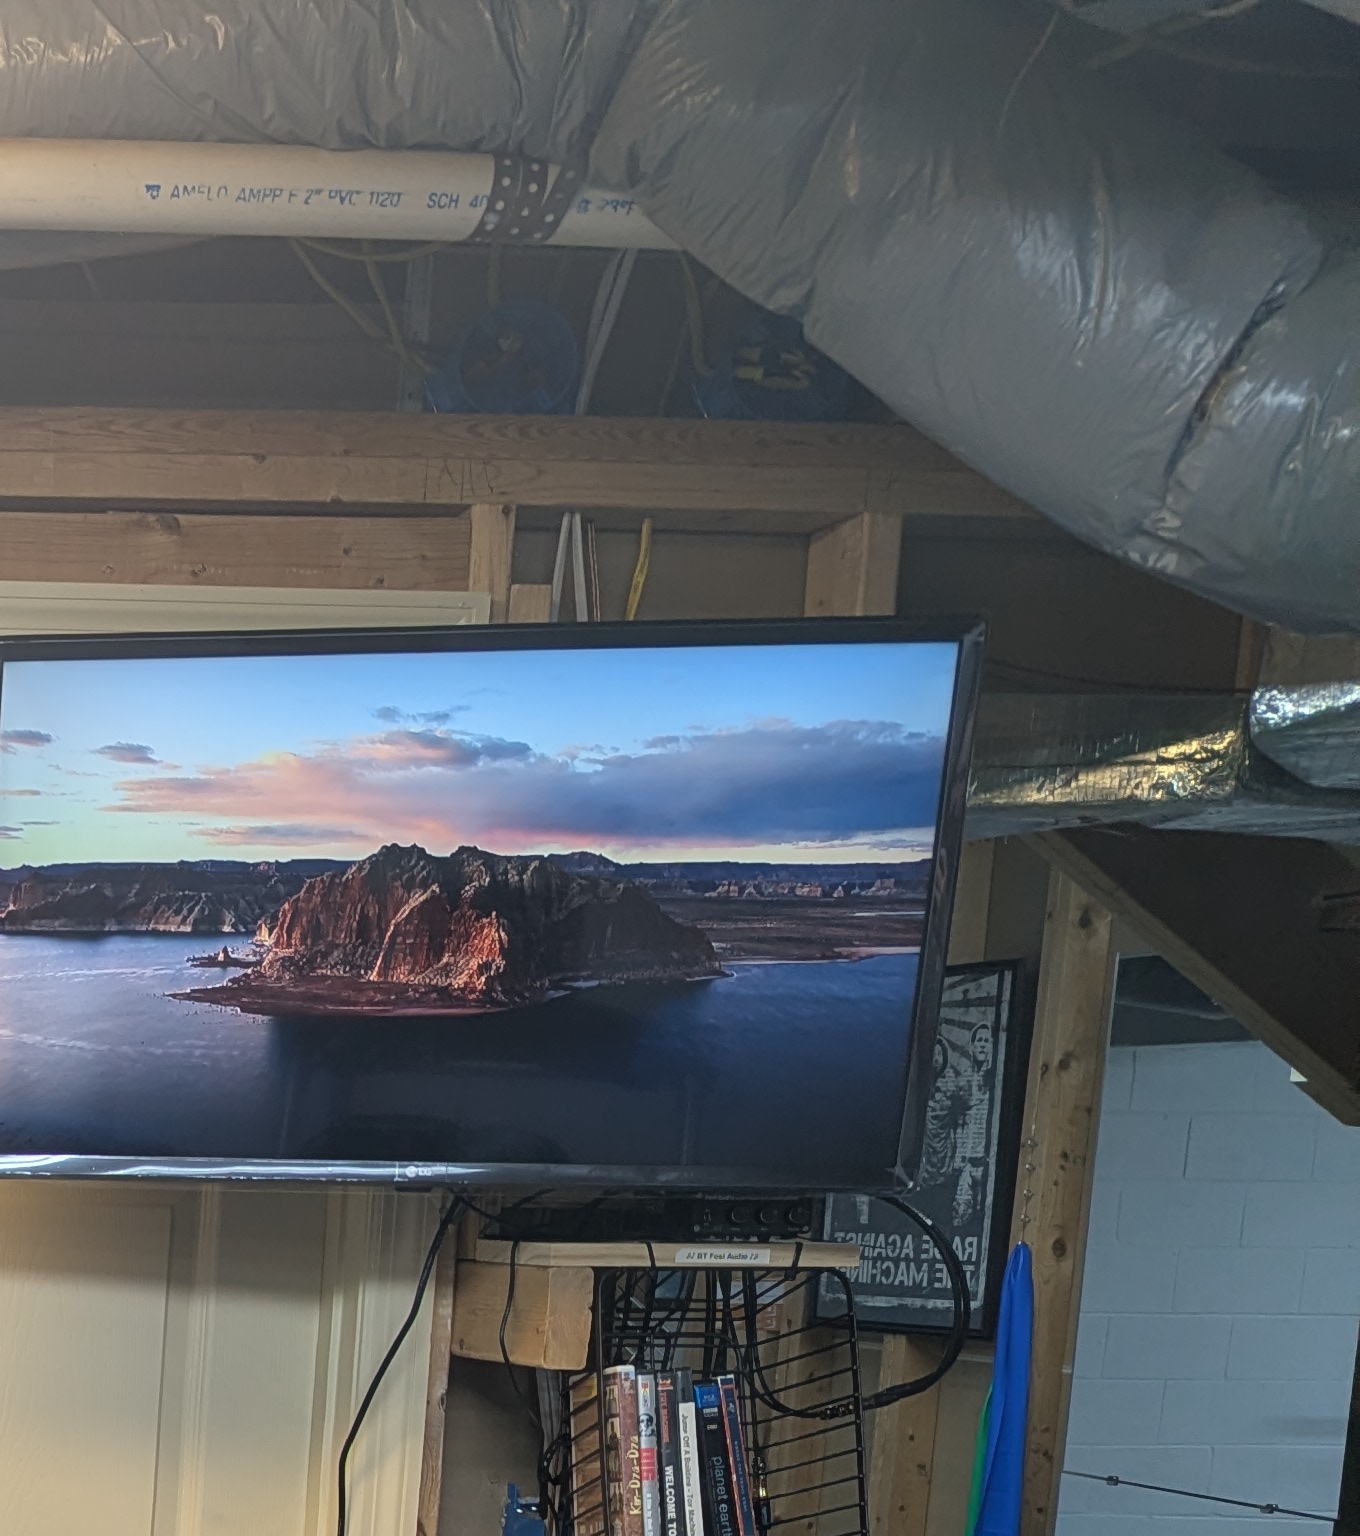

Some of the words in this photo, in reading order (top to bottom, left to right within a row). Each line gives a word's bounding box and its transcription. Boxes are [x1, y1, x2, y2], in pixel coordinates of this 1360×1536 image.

[427, 192, 460, 209] SCH
[665, 1465, 677, 1520] WELCOME
[711, 1456, 729, 1500] planet
[668, 1522, 677, 1536] TO
